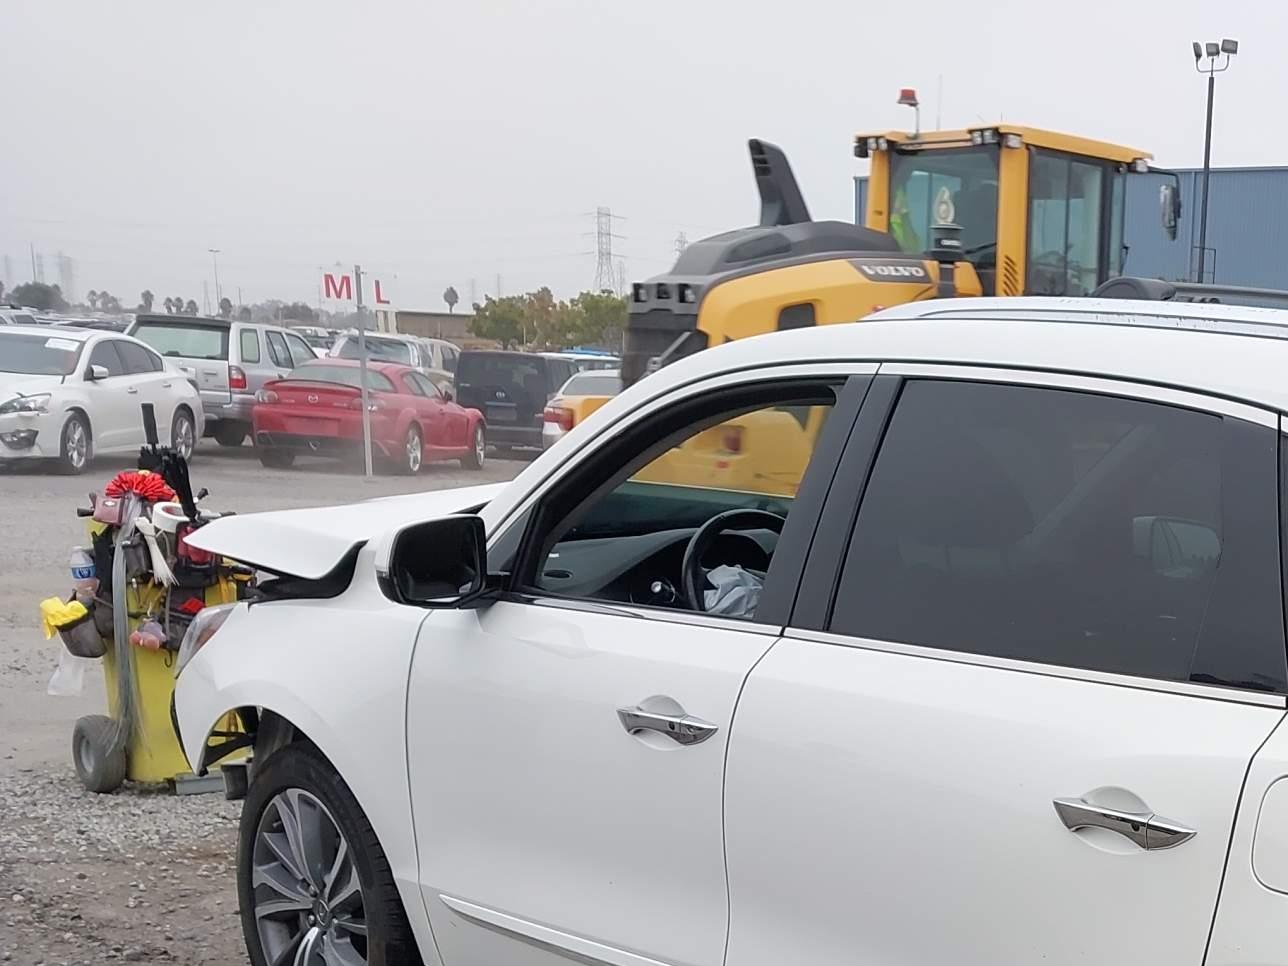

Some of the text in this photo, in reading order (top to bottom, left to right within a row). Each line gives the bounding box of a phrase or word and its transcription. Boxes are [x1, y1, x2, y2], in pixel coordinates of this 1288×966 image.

[863, 266, 924, 277] VOLVO
[324, 274, 391, 305] M L
